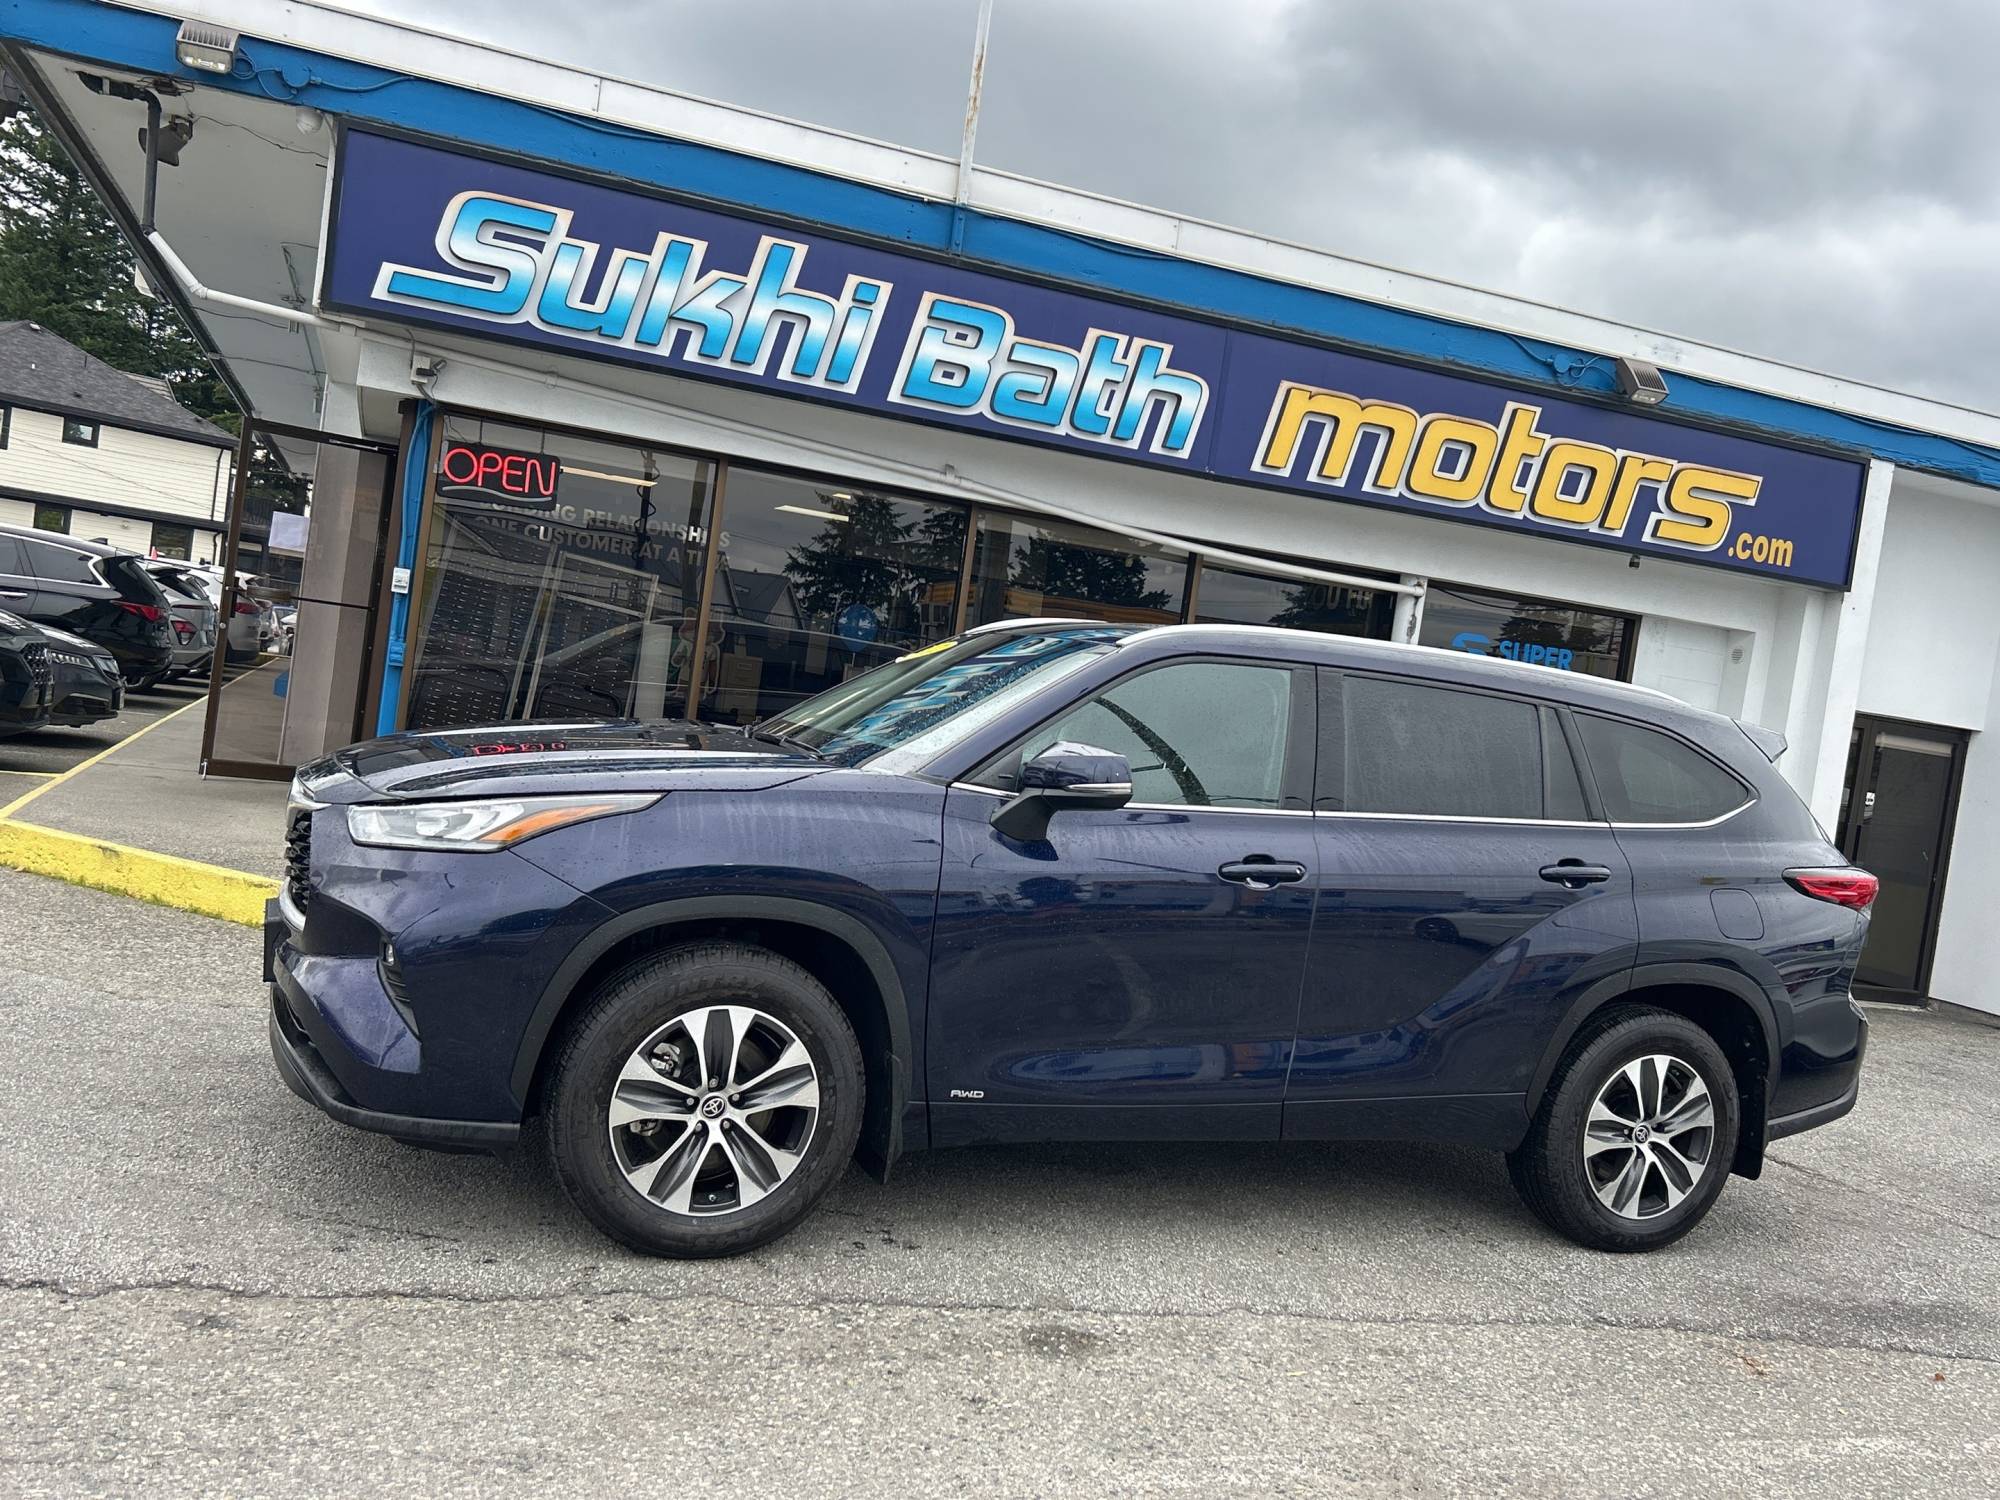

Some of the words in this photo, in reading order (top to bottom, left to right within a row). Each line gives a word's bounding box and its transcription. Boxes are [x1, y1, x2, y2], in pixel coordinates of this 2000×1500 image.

[371, 190, 893, 394] Sukhi
[887, 291, 1209, 459] Bath
[1250, 380, 1763, 552] motors
[444, 448, 556, 495] OPEN
[524, 524, 633, 556] CUSTOMER
[639, 541, 663, 560] AT
[666, 547, 680, 564] A
[583, 508, 731, 548] RELATIONSHIS
[950, 1089, 985, 1099] AWD
